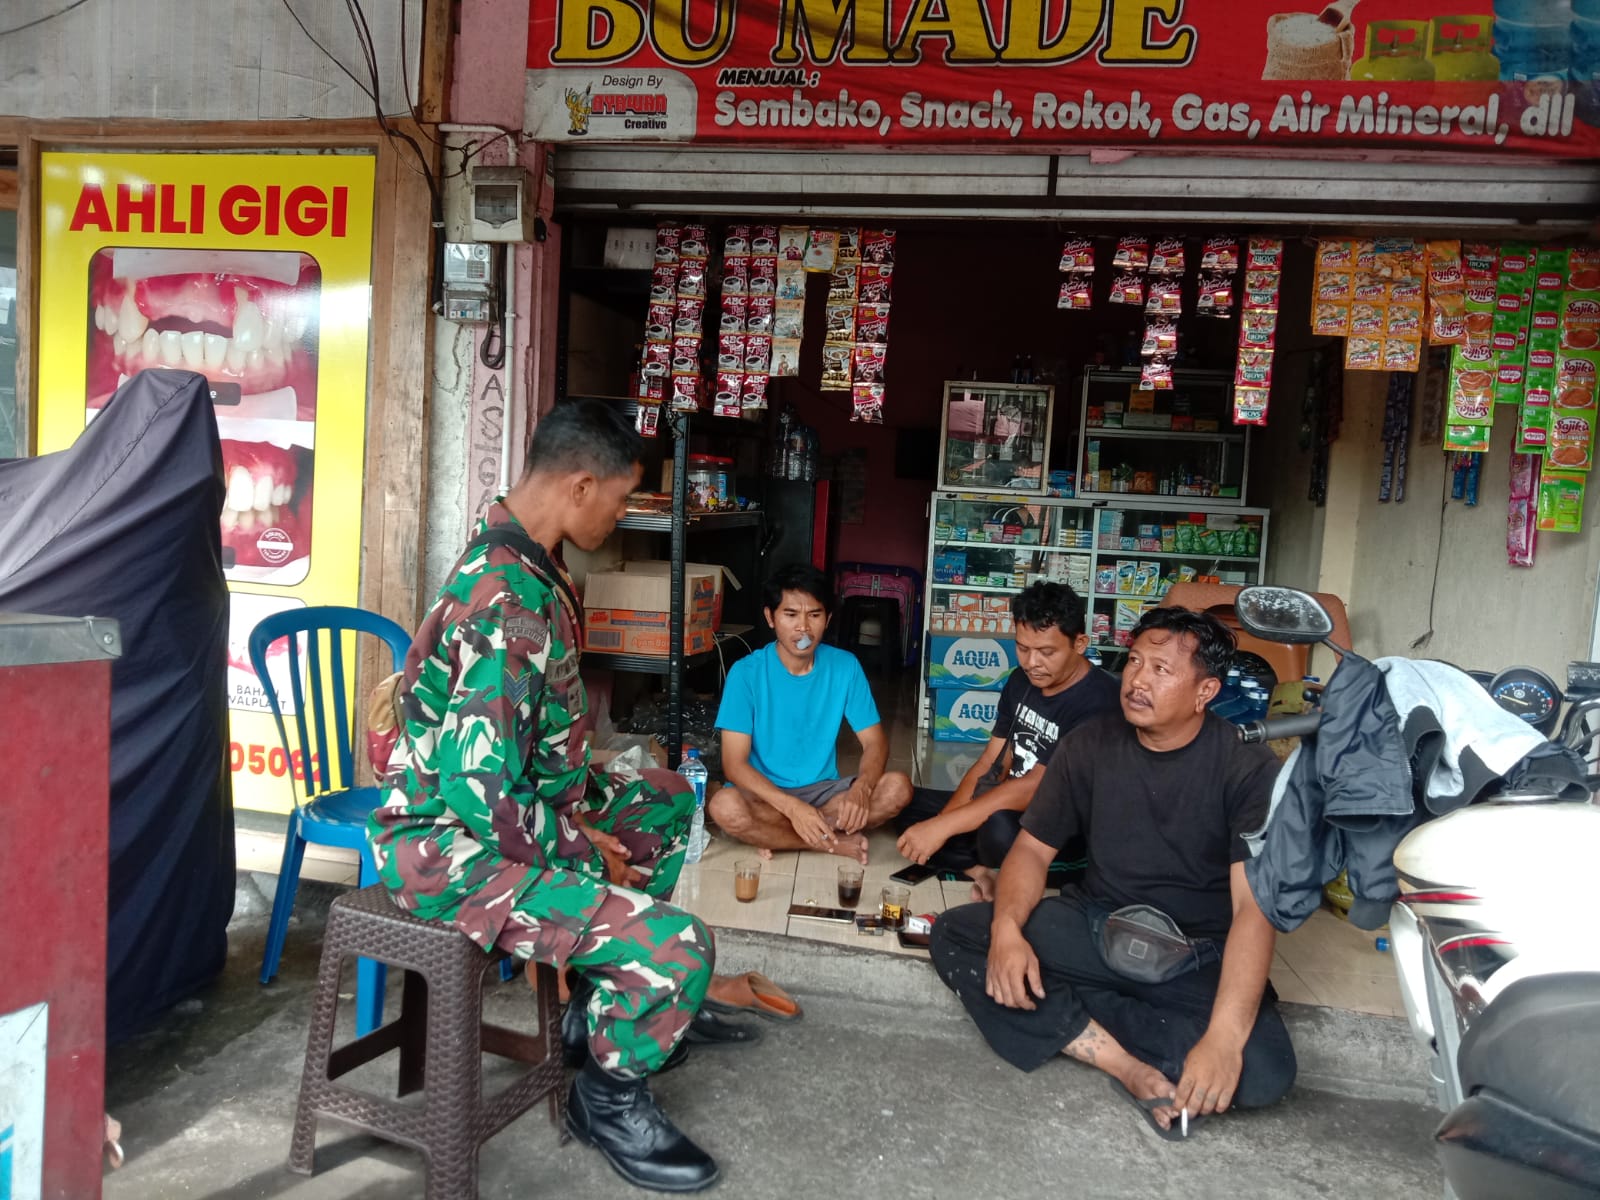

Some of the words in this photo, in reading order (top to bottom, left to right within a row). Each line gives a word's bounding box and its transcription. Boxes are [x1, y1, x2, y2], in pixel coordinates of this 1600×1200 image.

[550, 0, 737, 67] BU
[770, 0, 1198, 66] MADE
[602, 75, 643, 88] Design
[647, 75, 663, 88] By
[624, 118, 667, 129] Creative
[713, 89, 891, 136] Sembako,
[900, 90, 1023, 137] Snack,
[1032, 90, 1161, 138] Rokok,
[1171, 93, 1262, 140] Gas,
[1268, 91, 1330, 134] Air
[1335, 91, 1508, 144] Mineral,
[1518, 92, 1575, 137] dll
[69, 183, 206, 234] AHLI
[218, 184, 348, 237] GIGI
[1555, 418, 1589, 433] Sajiku
[952, 650, 1000, 669] AQUA
[958, 704, 998, 723] AQU
